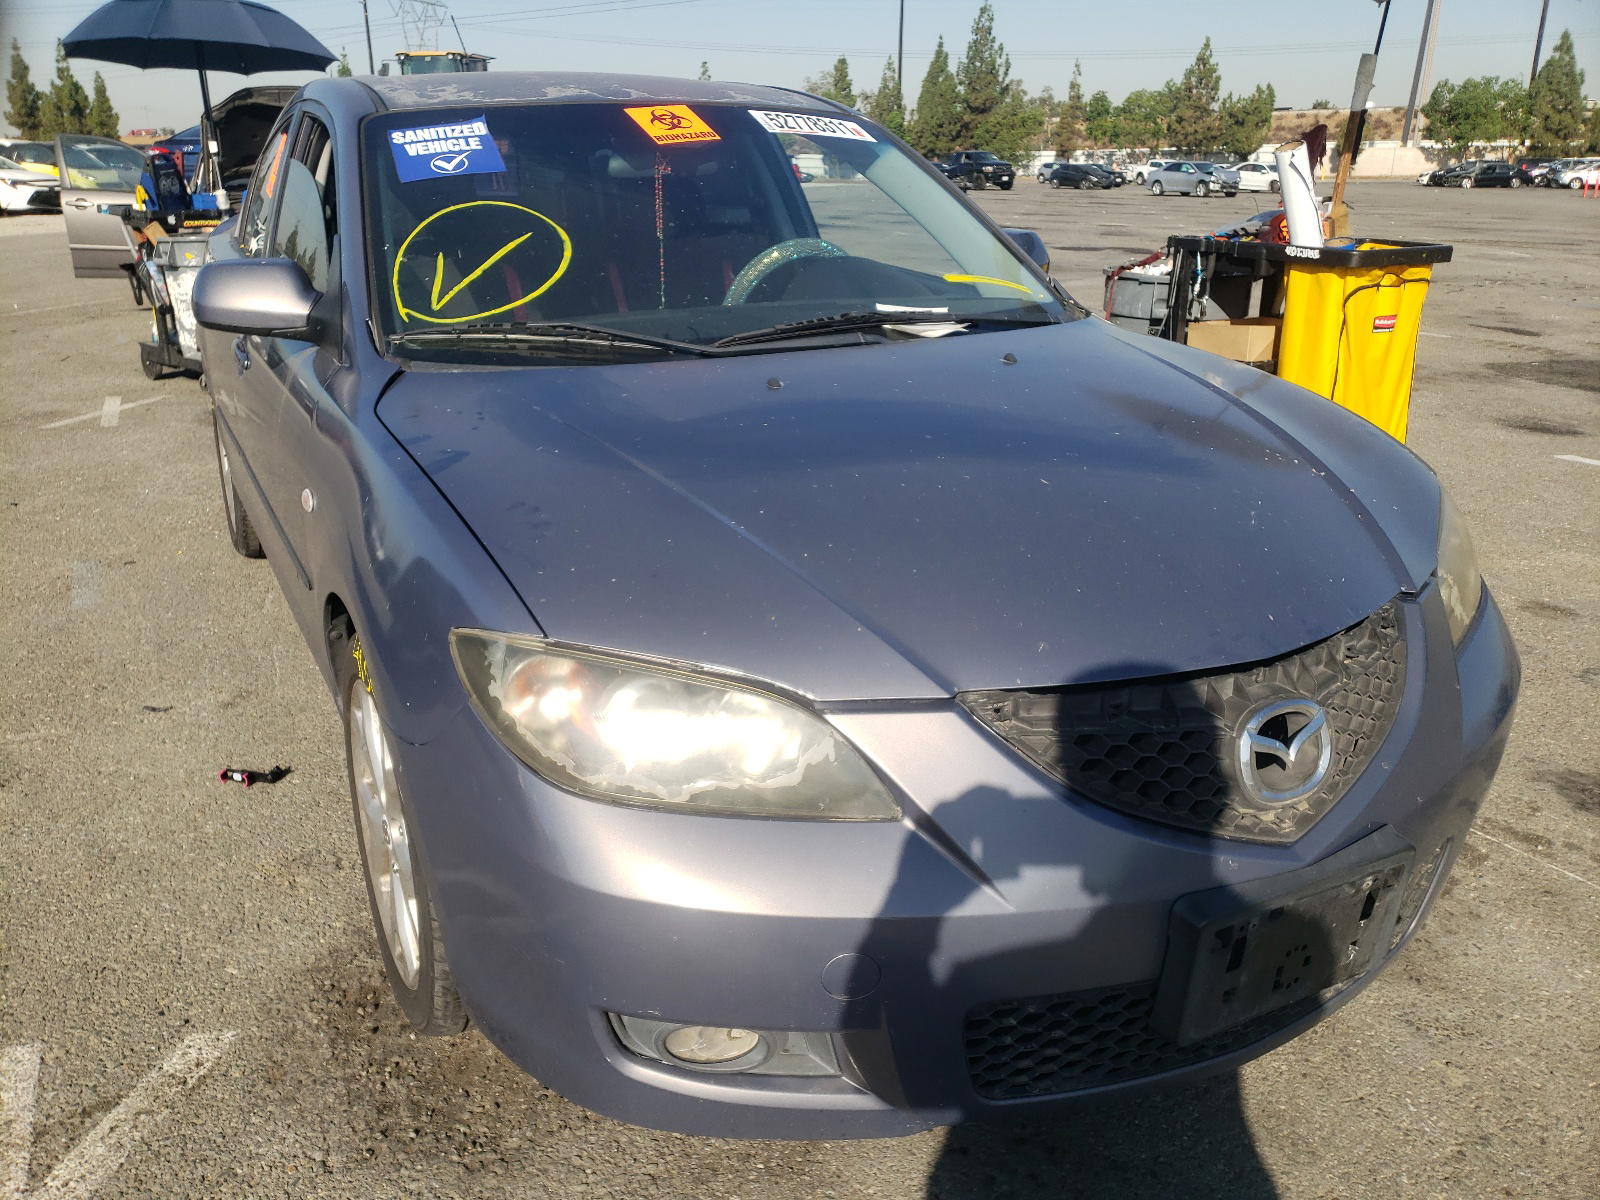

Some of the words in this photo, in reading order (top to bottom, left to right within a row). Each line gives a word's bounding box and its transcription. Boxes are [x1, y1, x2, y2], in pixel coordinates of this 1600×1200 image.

[391, 121, 487, 144] SANITIZED
[763, 112, 856, 136] 52778311
[404, 136, 484, 157] VEHICLE
[653, 131, 716, 142] BIOHAZARD
